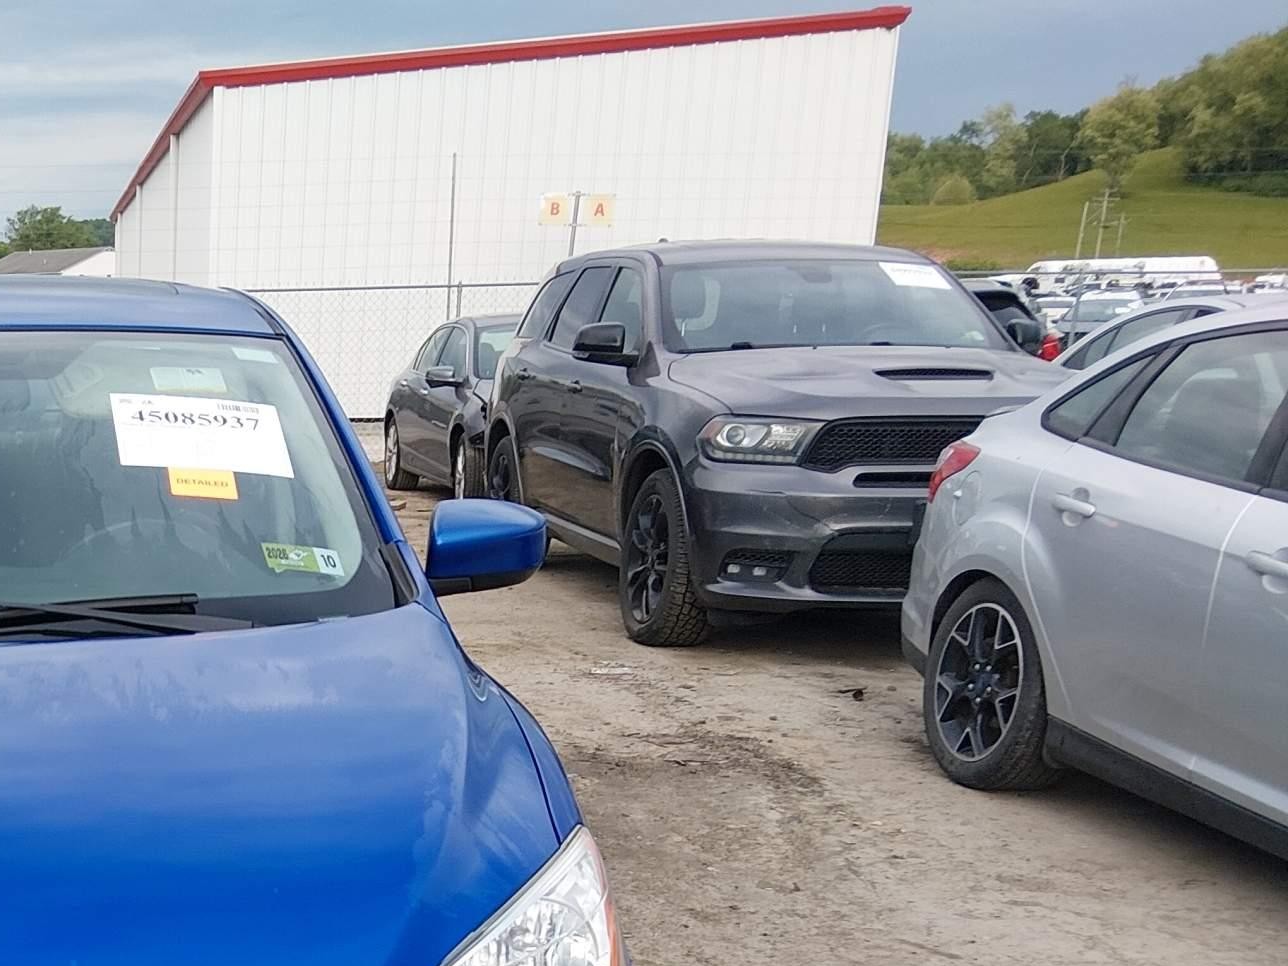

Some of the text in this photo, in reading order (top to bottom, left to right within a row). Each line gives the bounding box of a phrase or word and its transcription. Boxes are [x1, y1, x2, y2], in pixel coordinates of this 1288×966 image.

[550, 202, 561, 216] B
[594, 203, 605, 217] A
[130, 409, 260, 432] 45085937
[176, 477, 230, 488] DETAILED
[320, 554, 337, 569] 10
